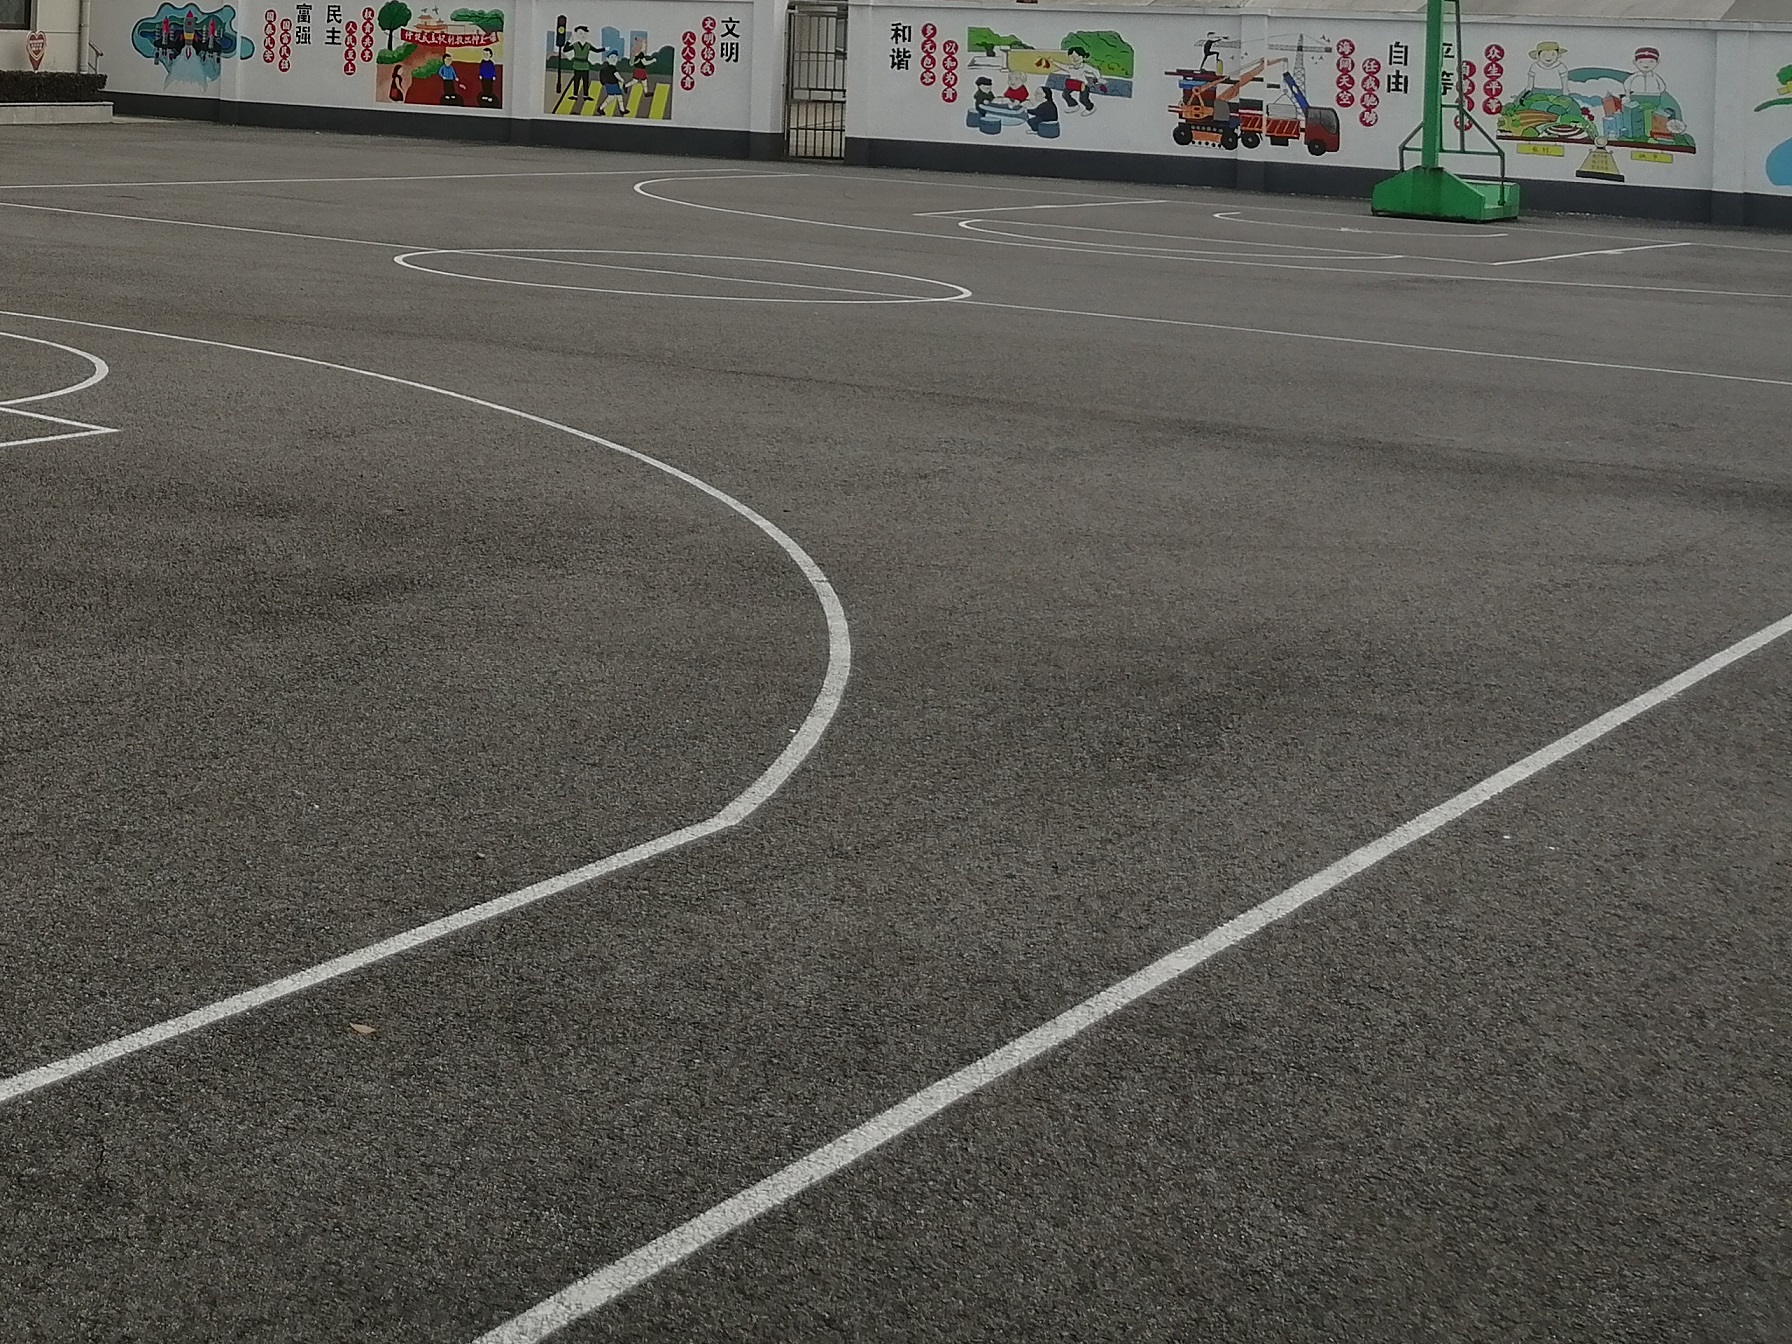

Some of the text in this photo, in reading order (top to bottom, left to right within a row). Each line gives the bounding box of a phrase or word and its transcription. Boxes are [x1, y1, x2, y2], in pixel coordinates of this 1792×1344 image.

[295, 3, 313, 45] 富强
[324, 4, 343, 46] 民主
[344, 22, 357, 74] 人民至上
[720, 16, 741, 63] 文明
[889, 22, 912, 70] 和谐
[681, 32, 695, 89] 人人有责
[921, 24, 936, 85] 多元包容
[943, 42, 958, 101] 以和为贵
[1337, 41, 1354, 106] 海阔天空
[1386, 41, 1409, 94] 自由
[1484, 46, 1503, 113] 众生平等
